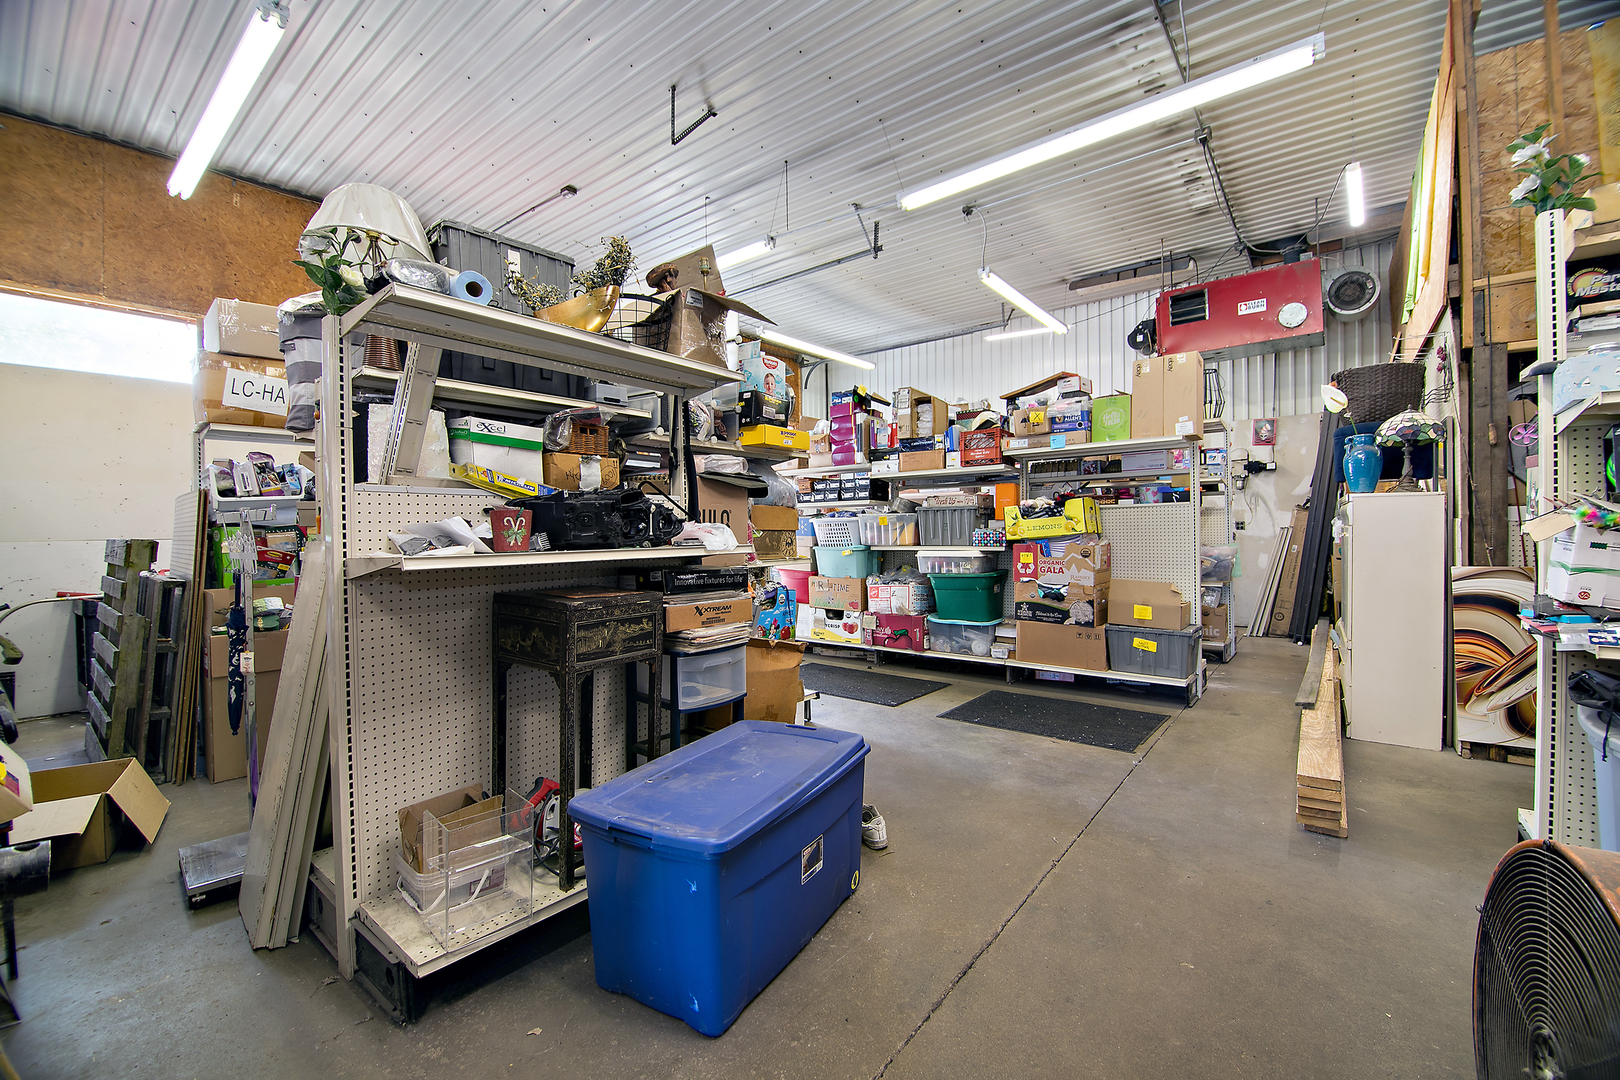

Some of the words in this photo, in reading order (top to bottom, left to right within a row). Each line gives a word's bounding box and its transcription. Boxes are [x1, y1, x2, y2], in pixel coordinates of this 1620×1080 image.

[231, 377, 286, 404] LC-HA
[1102, 410, 1121, 421] Hello
[1104, 418, 1121, 427] FRESH
[504, 479, 535, 491] MICHLIN
[1026, 523, 1063, 532] LEMONS
[1039, 566, 1065, 574] GALA
[675, 576, 704, 586] Innovative
[704, 576, 726, 584] fixtures
[725, 575, 734, 583] for
[733, 574, 744, 582] life
